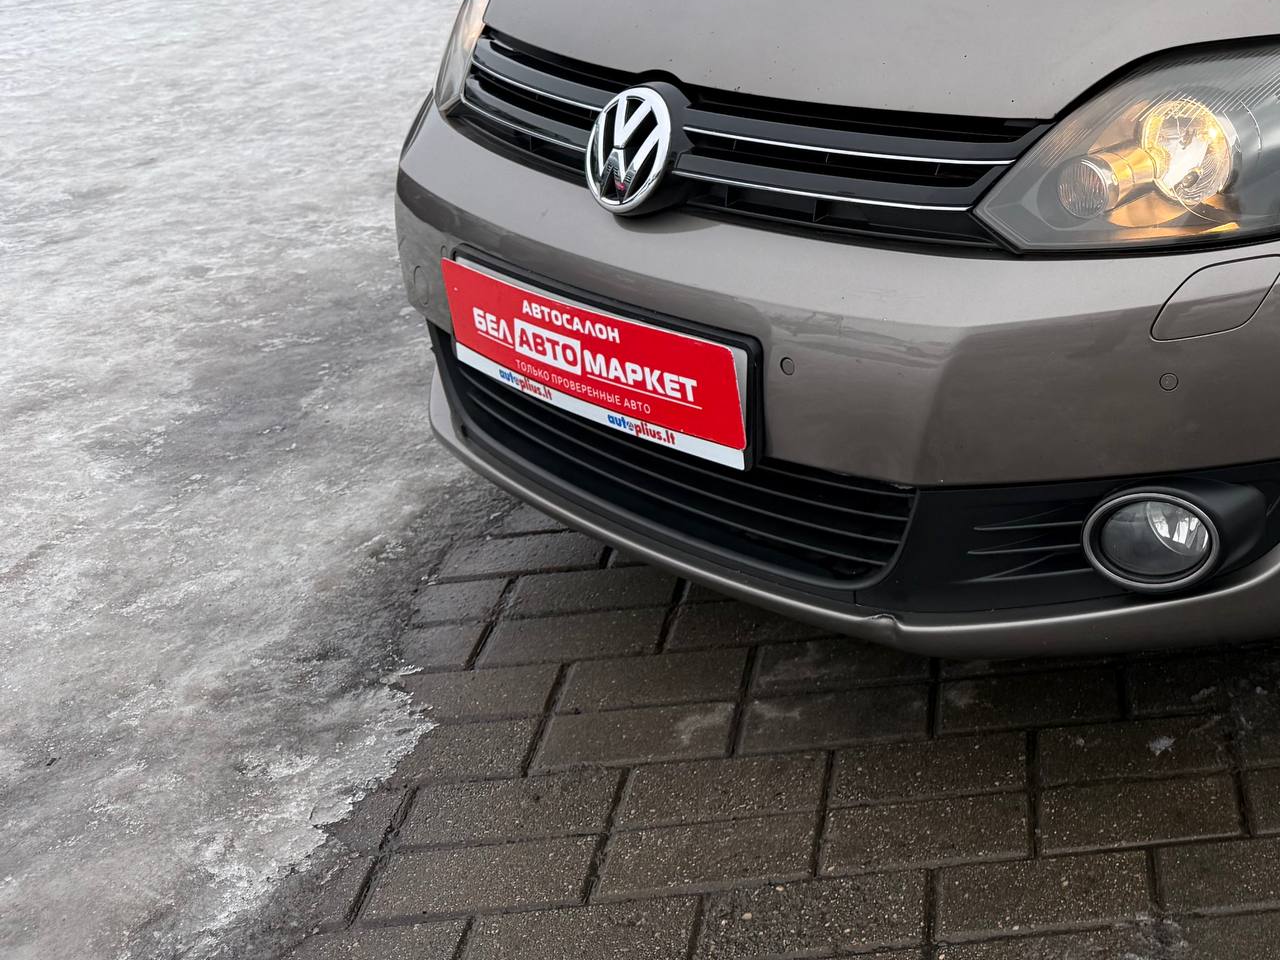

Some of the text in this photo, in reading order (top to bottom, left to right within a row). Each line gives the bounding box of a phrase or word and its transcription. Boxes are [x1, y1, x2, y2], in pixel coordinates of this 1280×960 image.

[522, 300, 620, 343] АВТОСАЛОН
[515, 359, 651, 414] ТОЛЬКО ПРОВЕРЕННЫЕ АВТО
